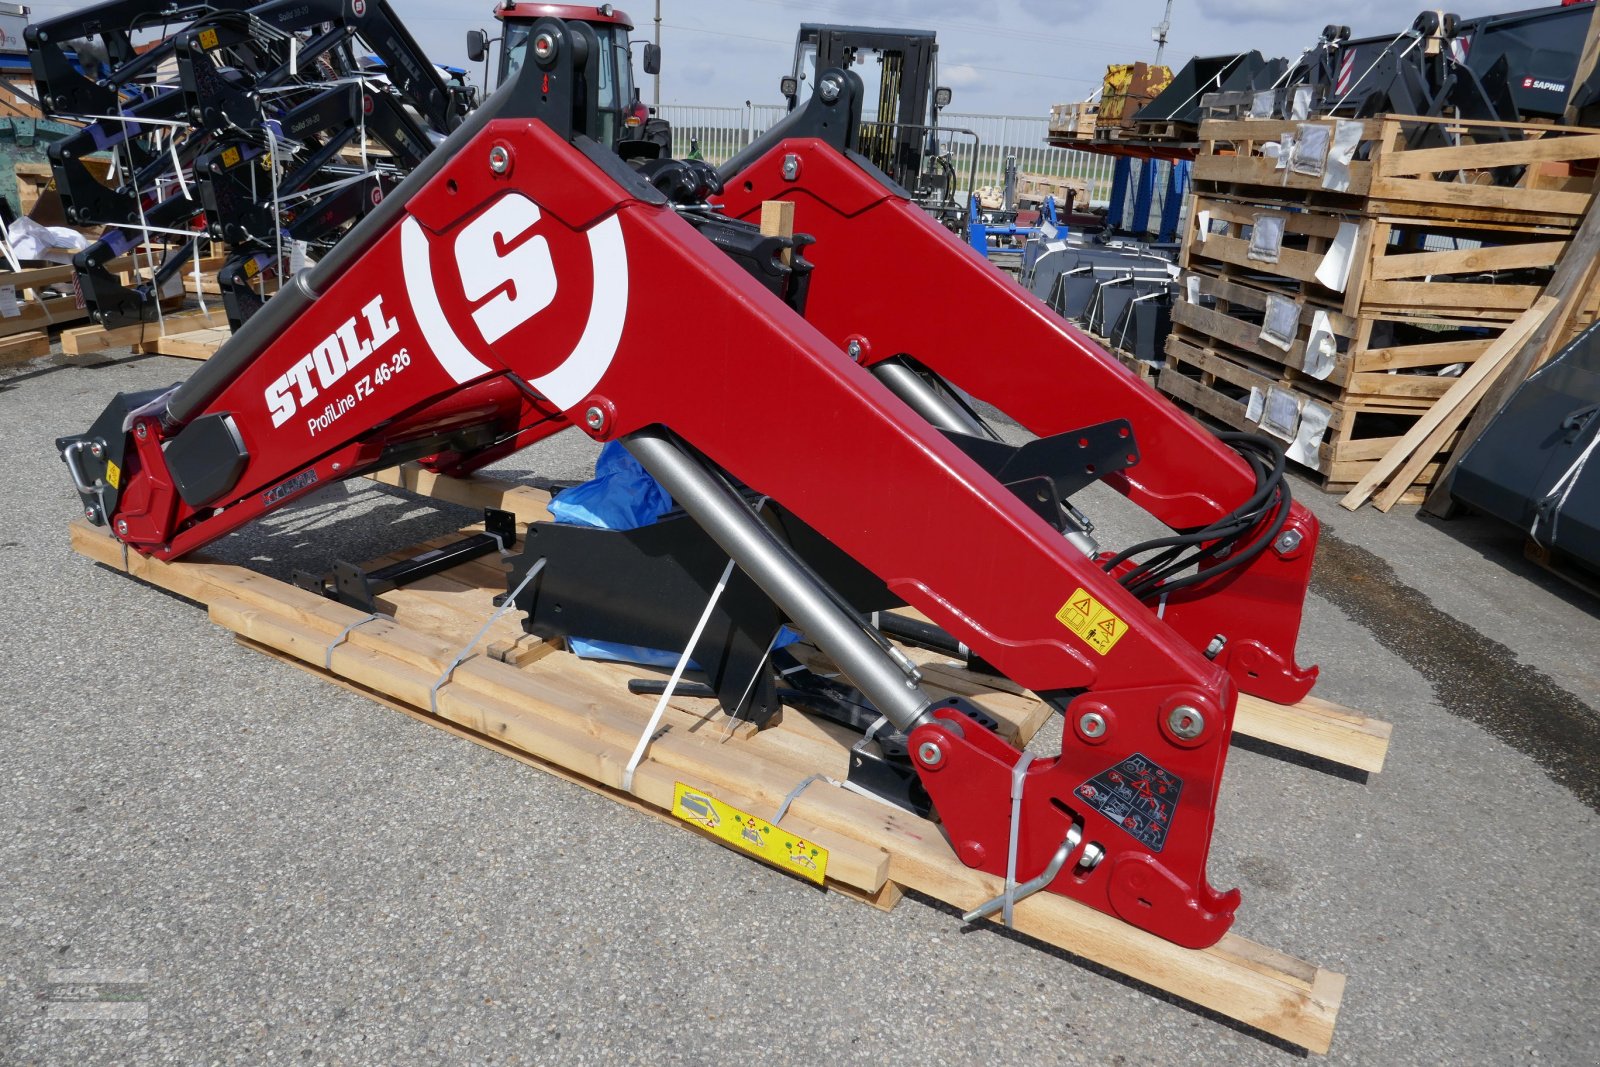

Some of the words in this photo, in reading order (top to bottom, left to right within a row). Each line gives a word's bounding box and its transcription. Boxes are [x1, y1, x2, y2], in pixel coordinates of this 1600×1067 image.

[290, 120, 306, 133] Solid
[1533, 80, 1565, 92] SAPHIR
[454, 193, 558, 346] S
[264, 294, 400, 429] STOLL
[307, 392, 356, 437] ProfiLine
[355, 376, 375, 402] FZ
[374, 347, 411, 385] 46-26
